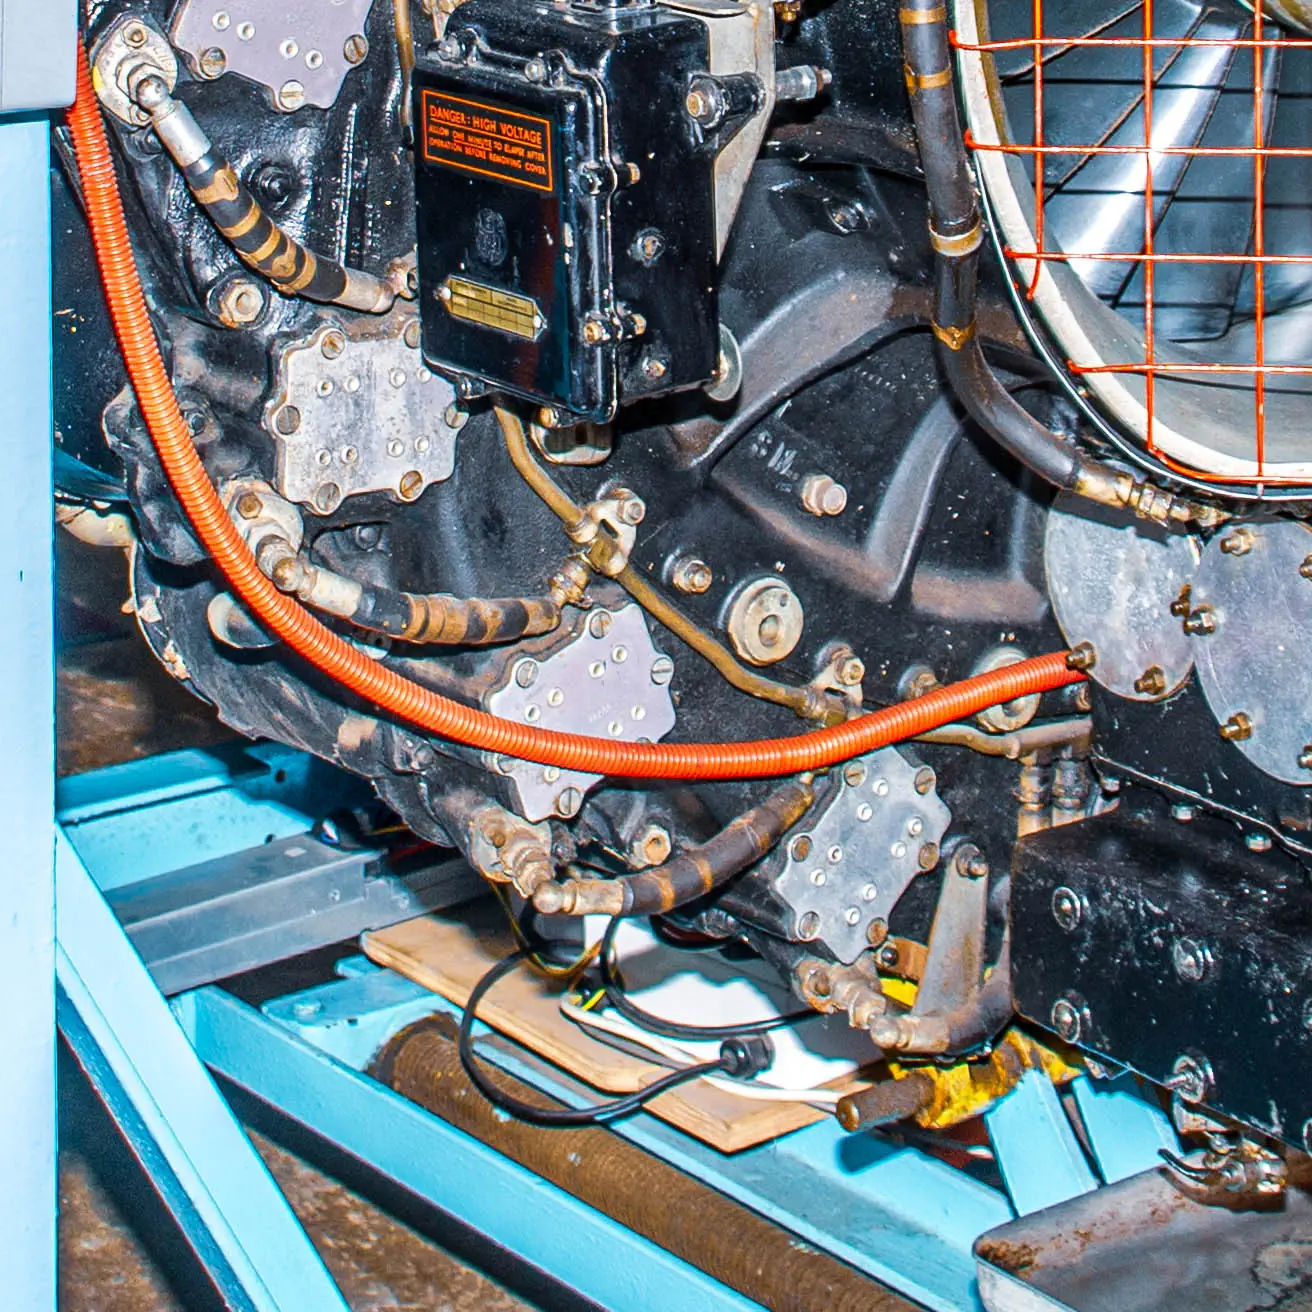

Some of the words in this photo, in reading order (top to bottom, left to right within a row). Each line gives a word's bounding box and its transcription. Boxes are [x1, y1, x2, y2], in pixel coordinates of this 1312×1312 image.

[429, 125, 449, 136] ALLOW
[453, 131, 464, 141] ONE
[467, 134, 492, 148] MINUTE
[493, 140, 503, 151] TO
[504, 144, 526, 158] ELAPSE
[527, 149, 546, 162] AFTER
[473, 115, 497, 132] HIGH
[501, 123, 542, 144] VOLTAGE
[429, 137, 462, 152] OPERATION
[463, 146, 487, 160] BEFORE
[489, 152, 522, 169] REMOVING
